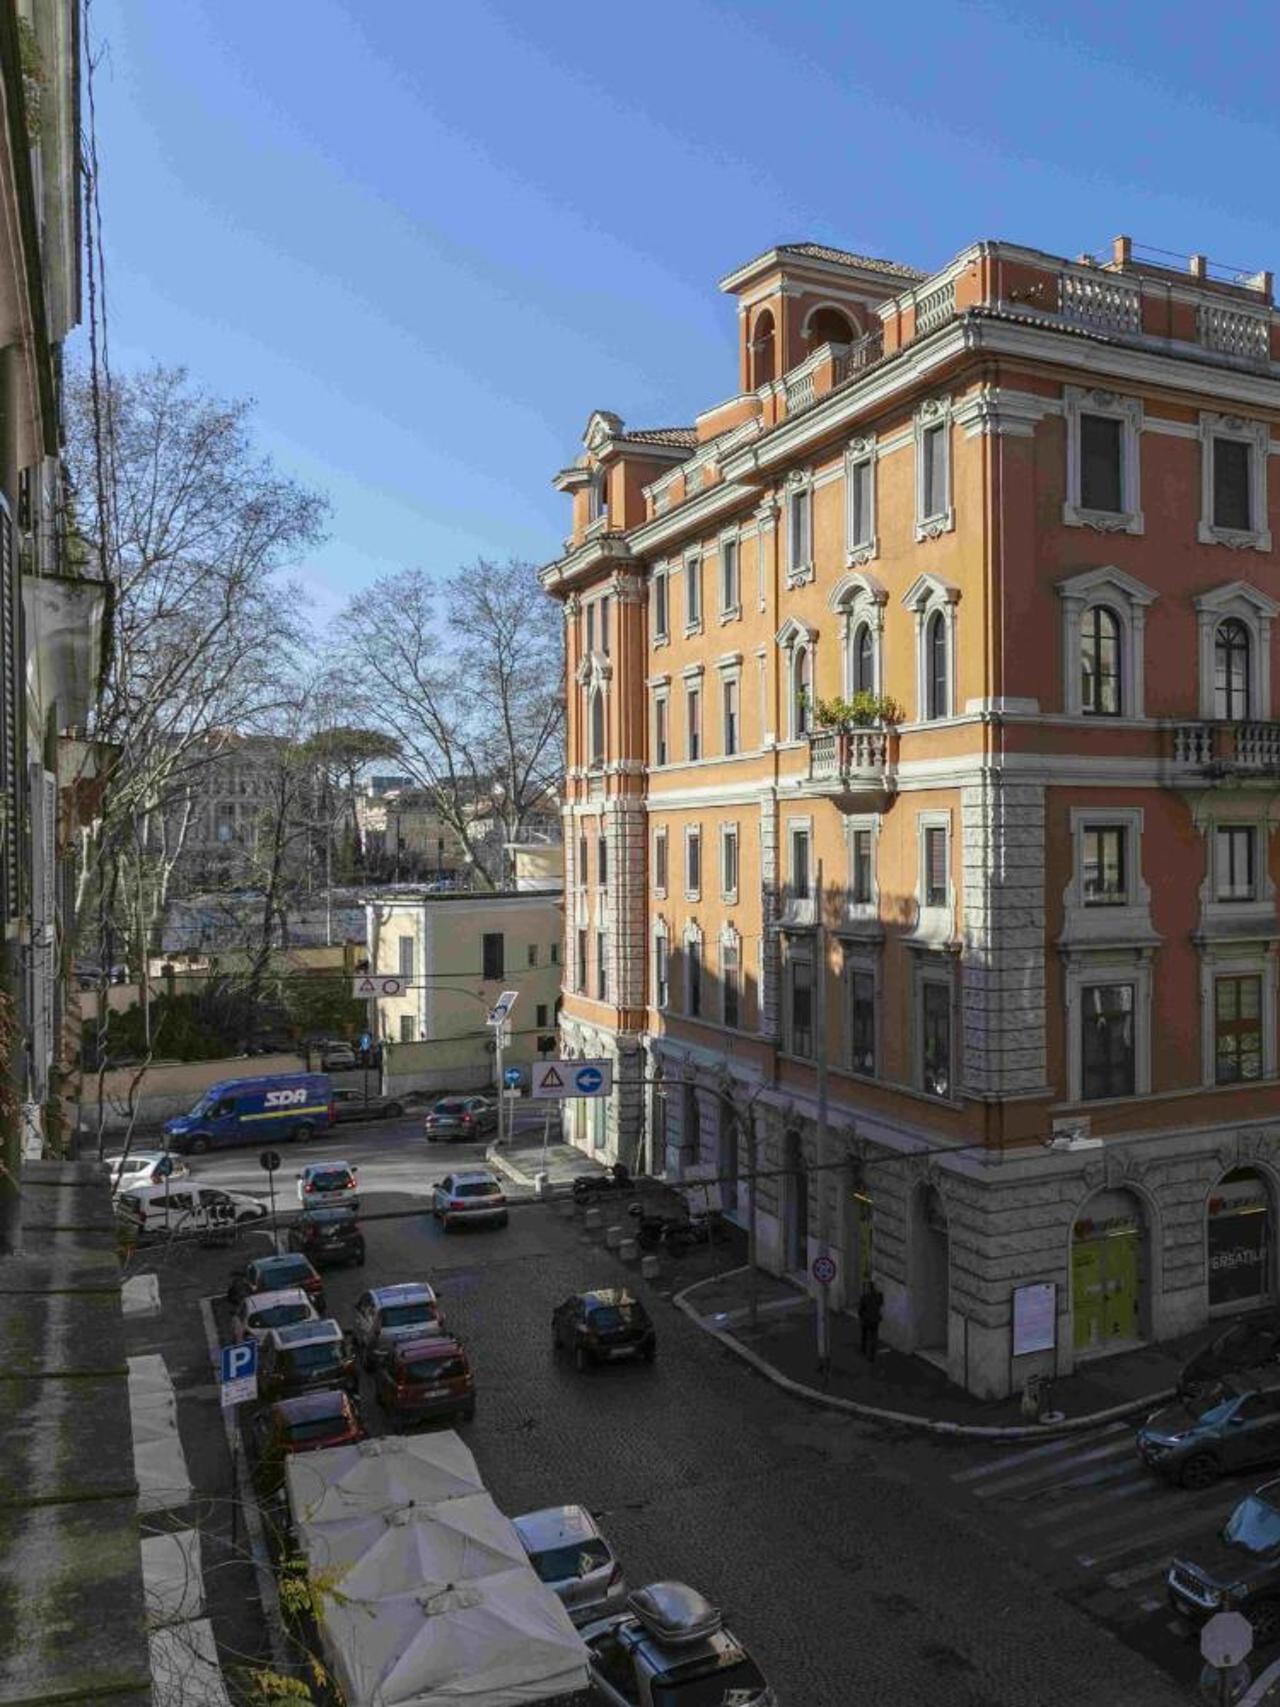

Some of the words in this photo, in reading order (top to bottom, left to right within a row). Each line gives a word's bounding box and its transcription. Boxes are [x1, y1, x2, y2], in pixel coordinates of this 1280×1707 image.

[264, 1088, 307, 1107] SDA
[1210, 1247, 1267, 1270] ERSATILE
[229, 1346, 251, 1378] P
